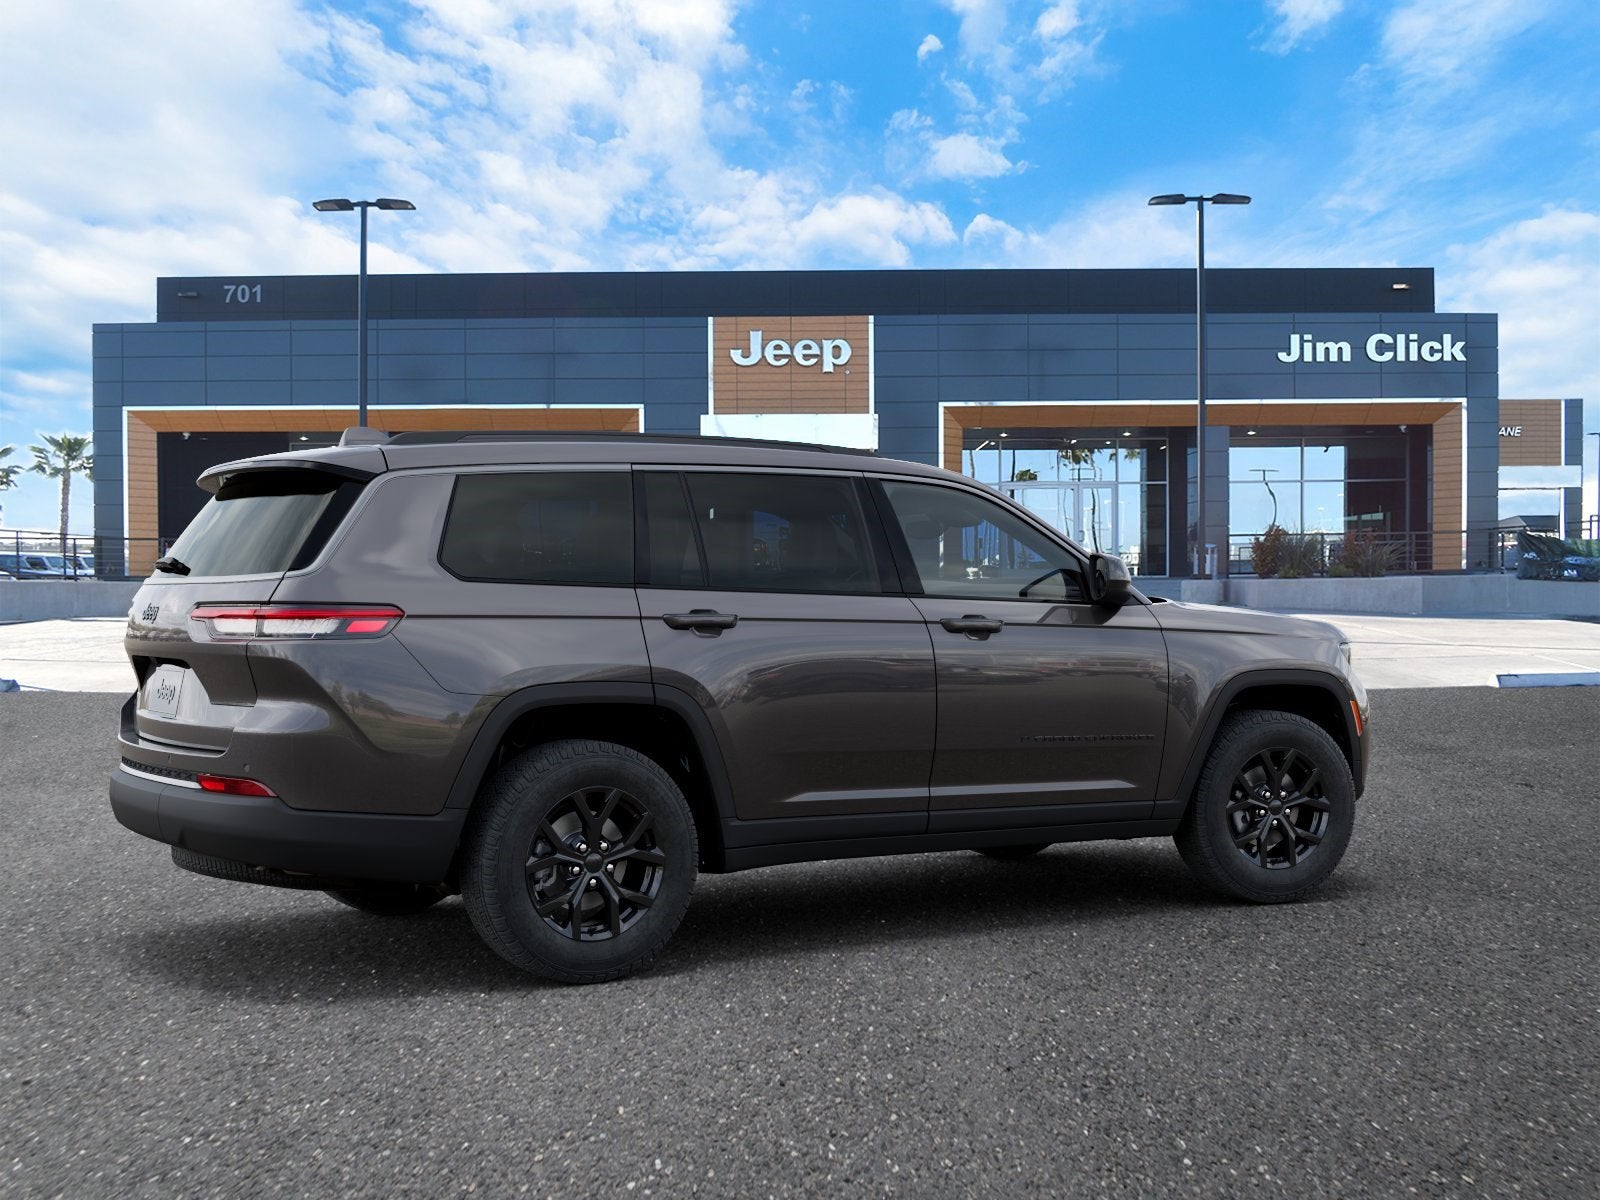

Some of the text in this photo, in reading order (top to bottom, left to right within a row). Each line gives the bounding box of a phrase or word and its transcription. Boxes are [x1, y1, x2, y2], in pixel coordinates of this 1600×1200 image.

[223, 284, 262, 303] 701
[729, 330, 852, 373] Jeep
[1277, 333, 1467, 362] Jim Click
[142, 602, 160, 624] Jeep
[157, 678, 176, 705] Jeep
